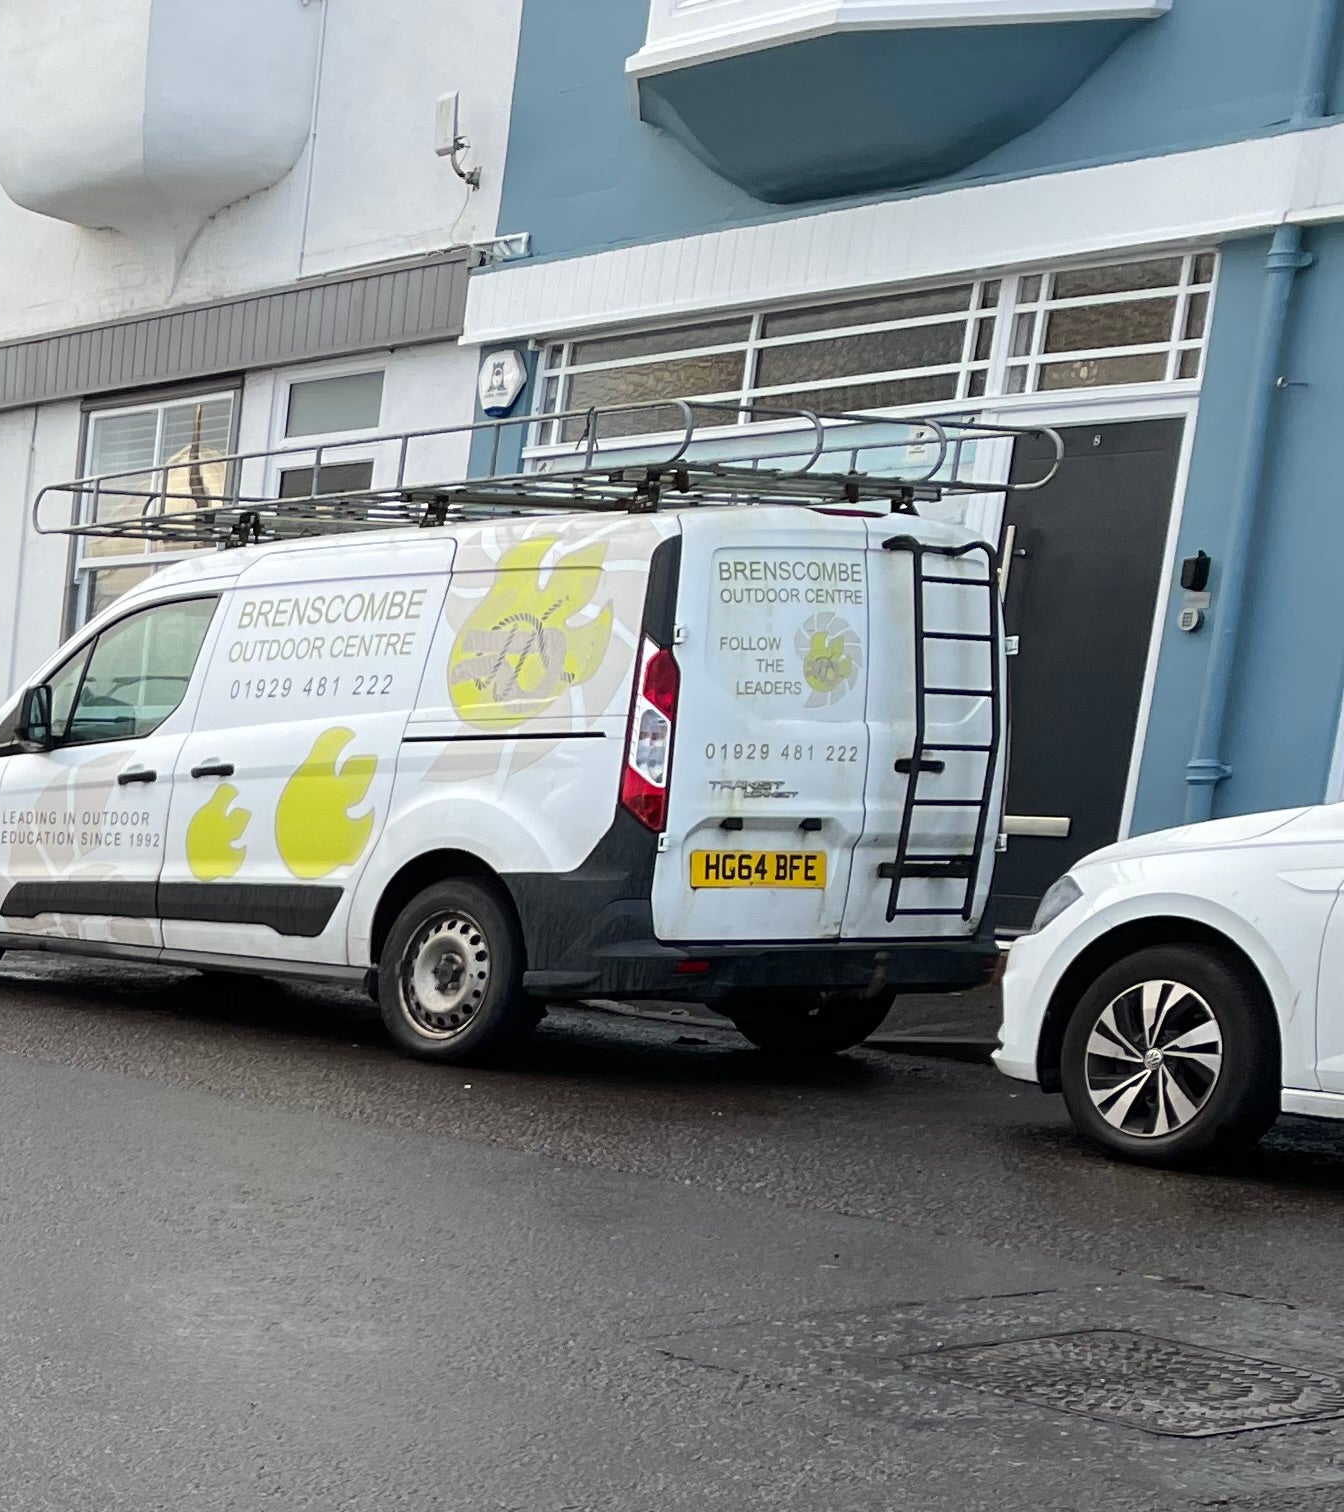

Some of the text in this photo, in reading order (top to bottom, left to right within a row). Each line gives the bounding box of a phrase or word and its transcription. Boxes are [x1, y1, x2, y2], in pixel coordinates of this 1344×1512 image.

[718, 561, 862, 582] BRENSCOMBE
[720, 588, 863, 605] OUTDOOR CENTRE
[237, 589, 428, 630] BRENSCOMBE
[228, 632, 416, 664] OUTDOOR CENTRE
[719, 636, 782, 651] FOLLOW
[756, 658, 785, 673] THE
[230, 674, 394, 700] 01929 481 222
[736, 681, 802, 696] LEADERS
[705, 743, 858, 762] 01929 481 222
[2, 811, 150, 826] LEADING IN OUTDOOR
[1, 830, 161, 848] EDUCATION SINCE 1992
[704, 853, 818, 881] HG64 BFE
